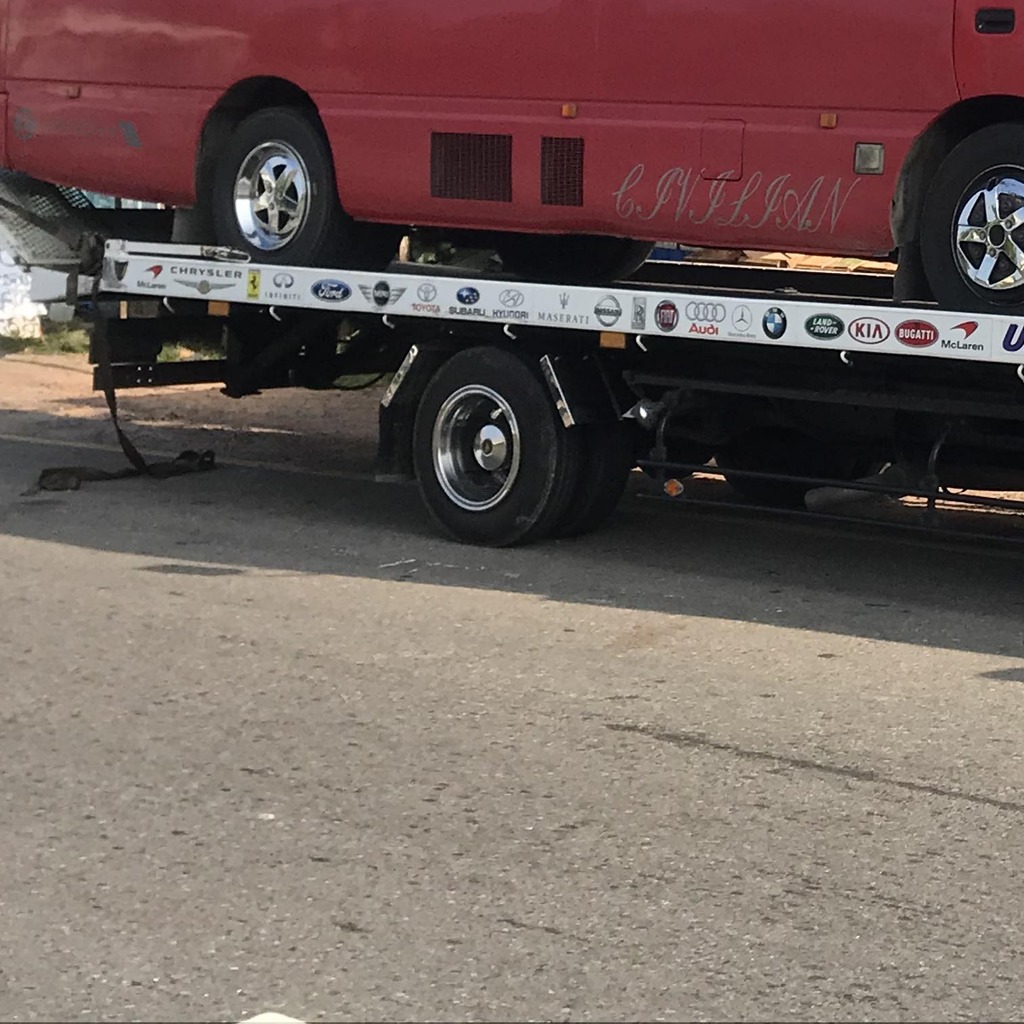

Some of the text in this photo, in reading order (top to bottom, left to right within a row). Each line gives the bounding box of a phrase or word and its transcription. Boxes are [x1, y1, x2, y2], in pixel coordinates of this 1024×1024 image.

[170, 265, 242, 279] CHRYSLER
[318, 283, 344, 299] Ford
[411, 303, 440, 314] TOYOTA
[448, 306, 486, 316] SUBARU
[596, 308, 621, 316] NISSAN
[537, 312, 589, 324] MASERATI
[688, 323, 719, 335] Audi
[855, 322, 883, 339] KIA
[898, 329, 934, 341] BUGATTI
[941, 339, 984, 351] McLaren
